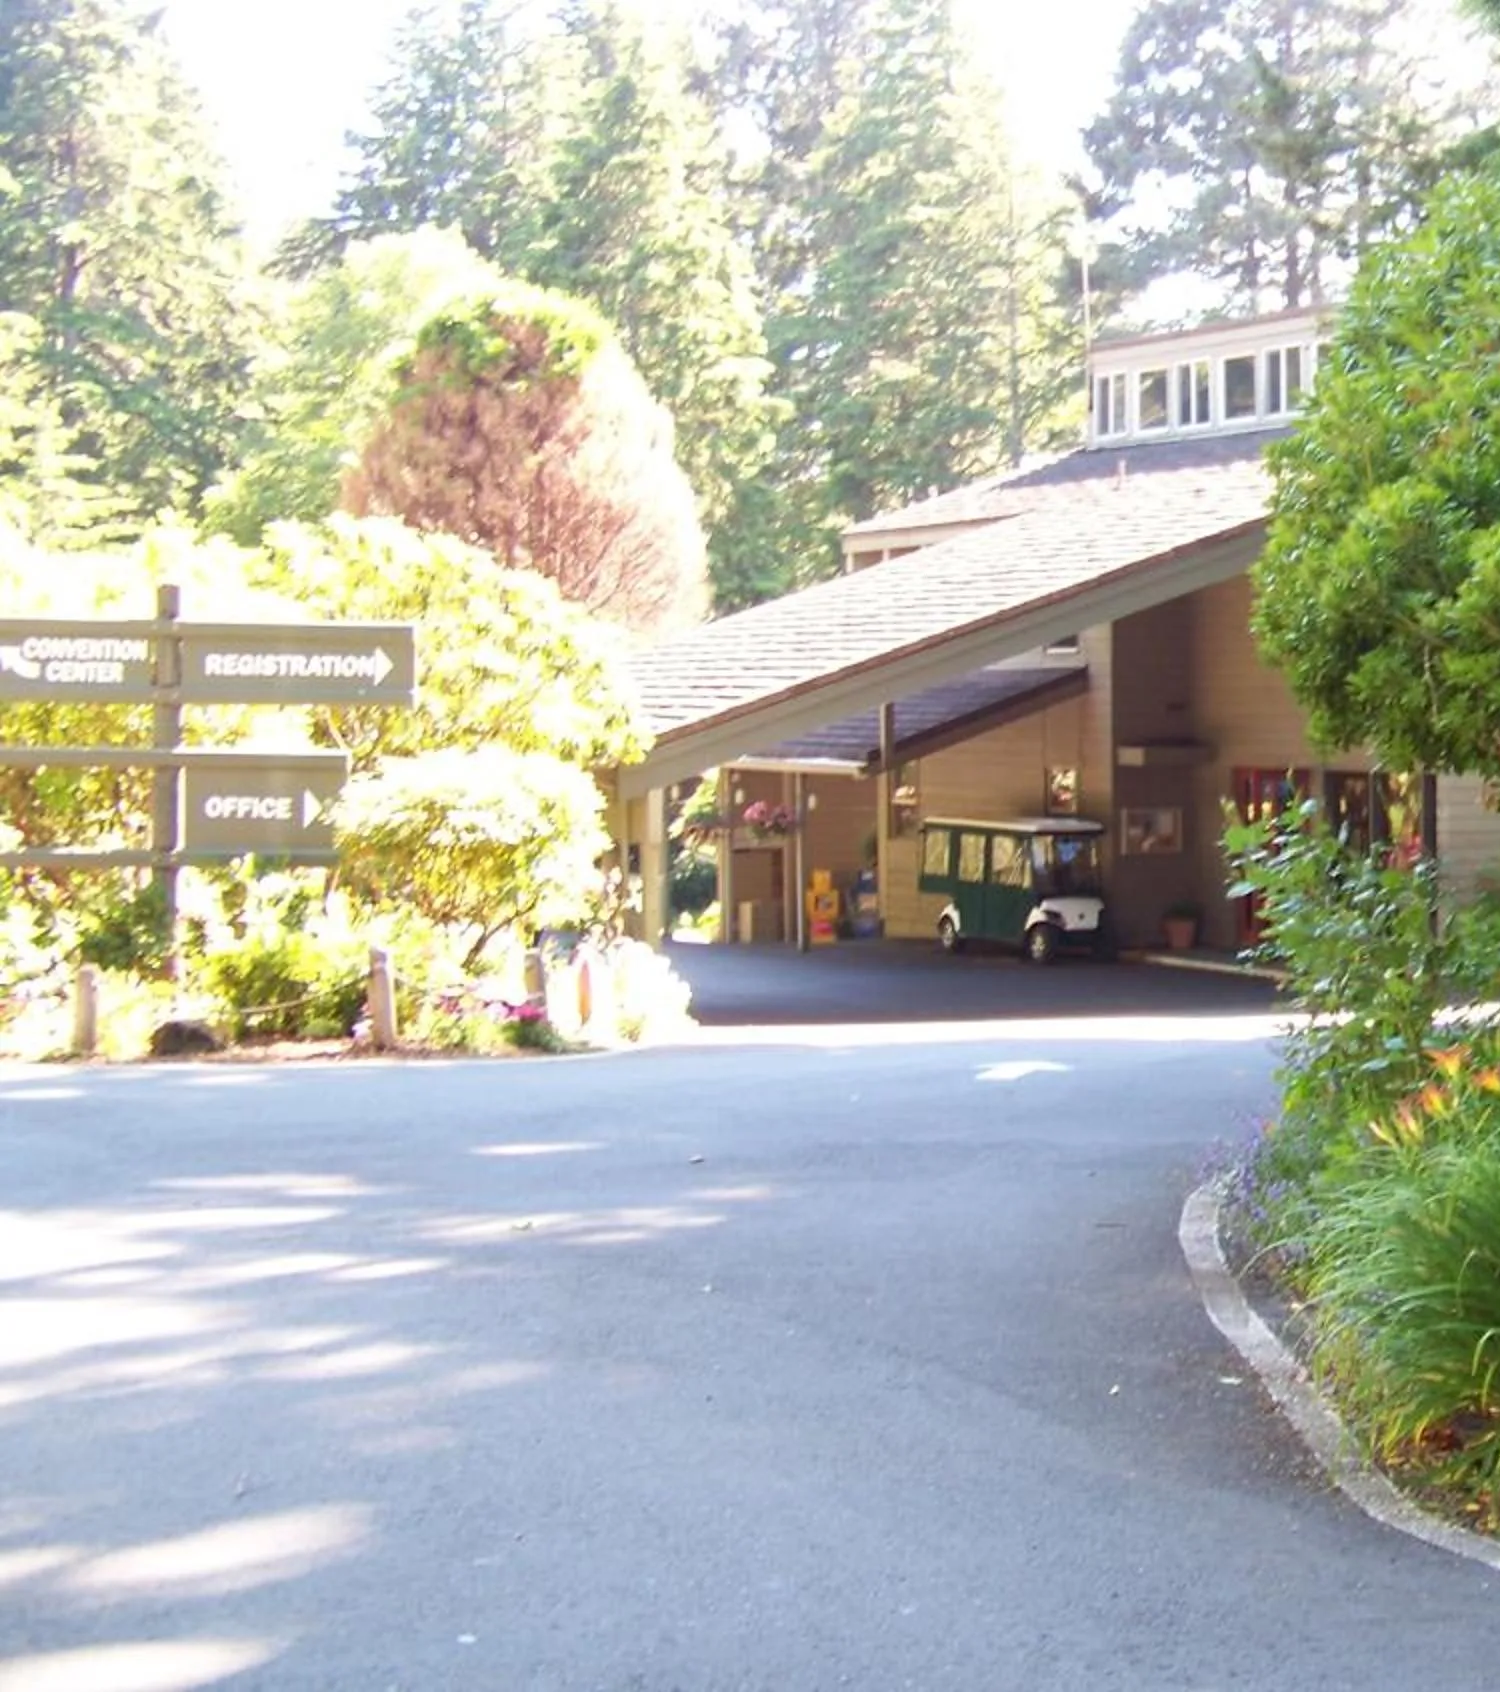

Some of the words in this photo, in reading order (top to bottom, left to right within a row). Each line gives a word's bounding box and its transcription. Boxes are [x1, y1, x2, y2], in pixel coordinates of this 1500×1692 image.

[22, 637, 148, 661] CONVENTION
[45, 660, 124, 683] CENTER
[204, 653, 375, 677] REGISTRATION
[205, 795, 293, 819] OFFICE
